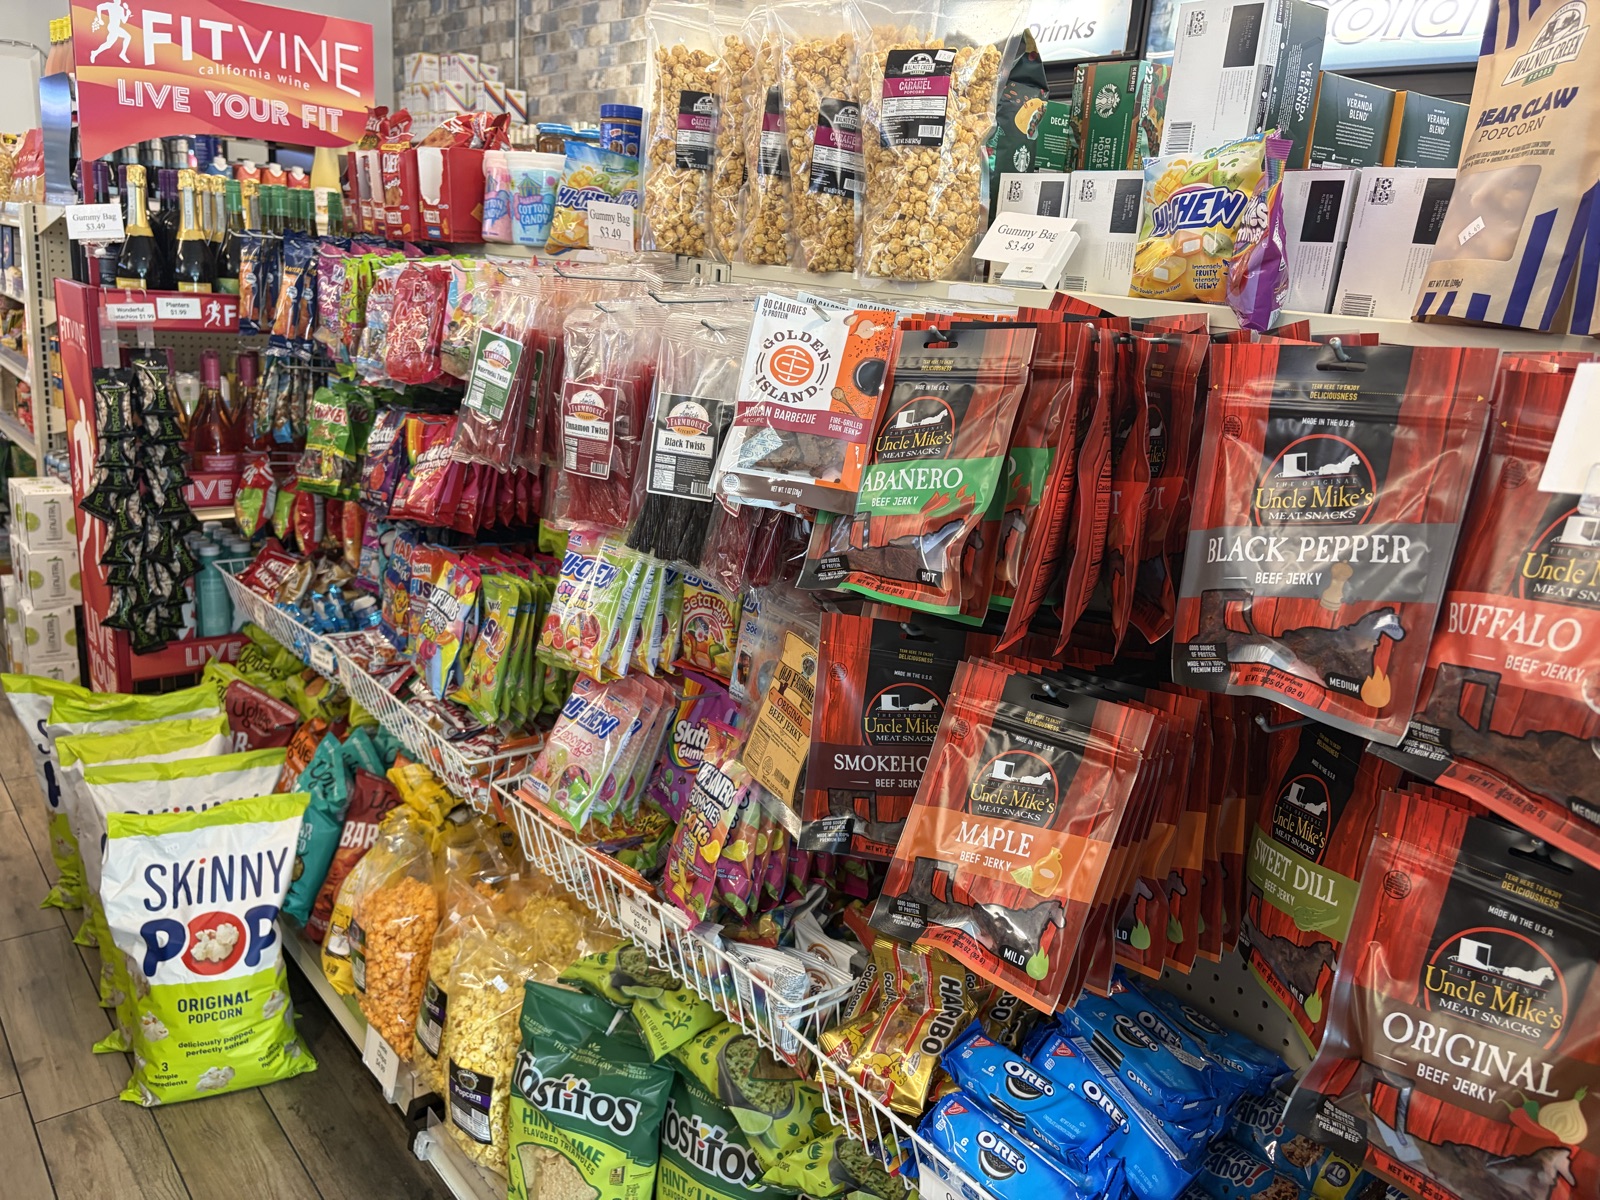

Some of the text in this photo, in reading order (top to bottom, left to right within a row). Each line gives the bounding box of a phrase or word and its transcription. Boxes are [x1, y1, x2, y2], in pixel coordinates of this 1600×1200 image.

[1028, 18, 1097, 43] Drinks
[141, 9, 362, 98] FITVINE
[1511, 31, 1583, 79] WALNUT CREEK
[199, 64, 311, 92] california wine
[1129, 67, 1138, 92] KEURIG
[1144, 66, 1153, 84] 22
[899, 81, 932, 91] CARAMEL
[1297, 62, 1313, 122] VERANDA
[117, 78, 344, 133] LIVE YOUR FIT
[1346, 97, 1373, 112] VERANDA
[1349, 109, 1367, 121] BLEND
[1475, 87, 1579, 131] BEAR CLAW
[1427, 113, 1449, 126] VERANDA
[1429, 124, 1446, 135] BLEND
[1478, 116, 1545, 142] POPCORN
[1096, 136, 1105, 168] HOUSE
[1103, 138, 1112, 167] DECAF
[72, 212, 118, 225] Gummy Bag
[518, 204, 550, 215] COTTON
[520, 213, 549, 224] CANDY
[589, 209, 631, 227] Gummy Bag
[1151, 187, 1248, 237] HI-CHEW
[86, 221, 106, 232] $3.49
[998, 224, 1059, 242] Gummy Bag
[1005, 240, 1035, 252] $3.49
[1195, 269, 1218, 278] FRUITY
[763, 299, 808, 316] 80 CALORIES
[769, 310, 789, 320] PROTEIN
[763, 329, 831, 362] GOLDEN
[755, 375, 818, 403] ISLAND
[1310, 391, 1358, 401] DELICIOUSNESS
[571, 404, 603, 417] FARMHOUSE
[774, 409, 816, 425] BARBECUE
[566, 421, 609, 436] Cinnamon Twists
[670, 418, 707, 433] FARMHOUSE
[828, 424, 842, 433] PORK
[829, 416, 863, 429] FIRE-GRILLED
[1302, 417, 1316, 426] MADE
[1326, 419, 1336, 427] THE
[665, 437, 706, 451] Black Twists
[876, 431, 953, 452] Uncle Mike's
[882, 447, 941, 459] MEAT SNACKS
[861, 467, 964, 494] ABANERO
[871, 496, 919, 507] BEEF JERKY
[1255, 486, 1373, 509] Uncle Mike's
[1268, 511, 1356, 520] MEAT SNACKS
[1207, 535, 1411, 563] BLACK PEPPER
[921, 571, 938, 584] HOT
[1255, 572, 1322, 585] BEEF JERKY
[1523, 552, 1584, 585] Uncle
[1533, 583, 1575, 599] MEAT
[683, 593, 734, 629] Getaway
[1448, 602, 1582, 652] BUFFALO
[899, 654, 933, 664] DELICIOUSNESS
[1504, 655, 1585, 684] BEEF JERKY
[780, 666, 792, 682] OLD
[1329, 677, 1359, 693] MEDIUM
[777, 697, 803, 727] ORIGINAL
[768, 705, 786, 727] BEEF
[783, 719, 803, 742] JERKY
[864, 718, 902, 734] Uncle
[834, 753, 928, 773] SMOKEHO
[875, 779, 895, 788] BEEF
[970, 783, 1055, 814] Uncle Mike's
[977, 803, 1040, 822] MEAT SNACKS
[1273, 804, 1326, 849] Uncle Mike's
[955, 821, 1034, 859] MAPLE
[1275, 828, 1316, 856] MEAT SNACKS
[960, 852, 1012, 872] BEEF JERKY
[1254, 837, 1292, 883] SWEET
[1293, 866, 1338, 907] DILL
[1264, 878, 1296, 907] BEEF JERKY
[1501, 880, 1560, 909] DELICIOUSNESS
[1488, 905, 1506, 918] MADE
[1518, 915, 1533, 929] THE
[140, 904, 280, 977] POP
[1003, 948, 1025, 966] MILD
[845, 963, 877, 1018] Goldbears
[1425, 965, 1562, 1030] Uncle Mike's
[177, 990, 253, 1013] ORIGINAL
[188, 1006, 243, 1024] POPCORN
[922, 976, 962, 1055] HARIBO
[1439, 998, 1542, 1039] MEAT SNACKS
[178, 1028, 256, 1049] deliciously popped,
[1115, 1014, 1159, 1052] OREO
[186, 1038, 249, 1058] perfectly salted
[1382, 1011, 1559, 1098] ORIGINAL
[154, 1072, 178, 1081] simple
[161, 1062, 169, 1072] 3
[1004, 1061, 1054, 1097] OREO
[1128, 1069, 1153, 1096] OREO
[1416, 1063, 1497, 1104] BEEF JERKY
[454, 1085, 482, 1102] Popcorn
[1083, 1080, 1130, 1134] OREO
[961, 1138, 969, 1147] 6
[1318, 1121, 1360, 1144] PREMIUM BEEF
[524, 1127, 595, 1176] FLAVORED TRIANGLES
[977, 1131, 1027, 1174] OREO
[661, 1167, 688, 1189] HINT
[1332, 1165, 1346, 1177] 10
